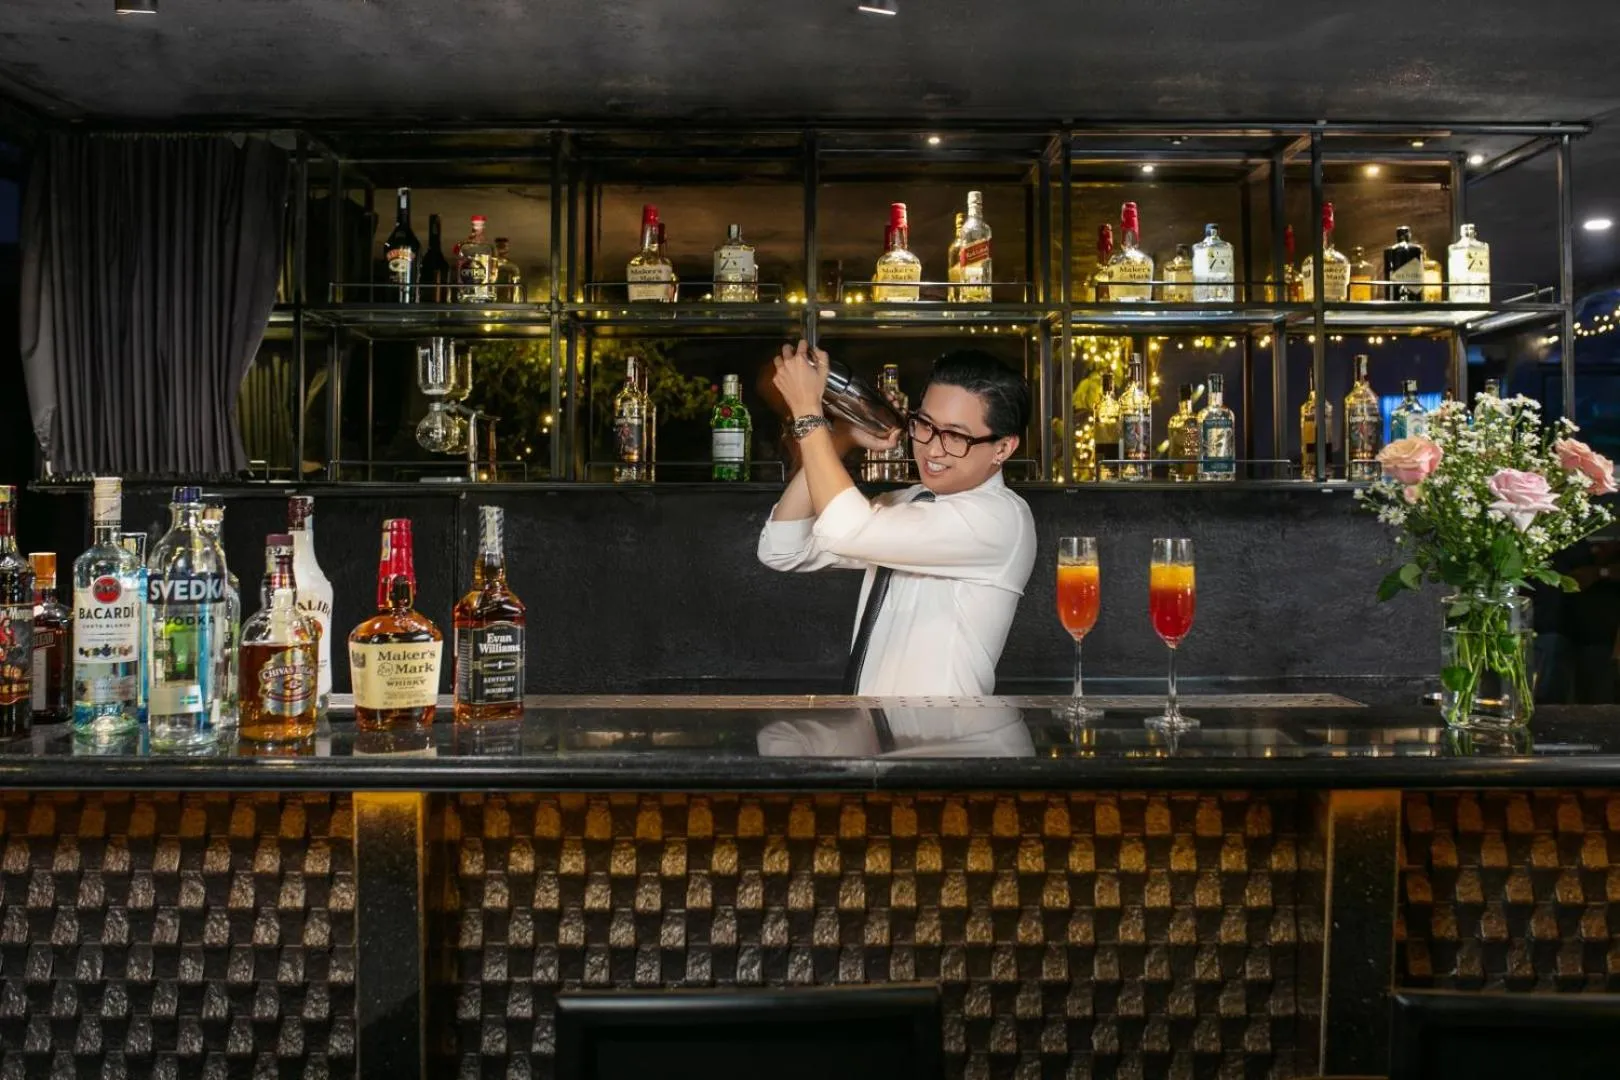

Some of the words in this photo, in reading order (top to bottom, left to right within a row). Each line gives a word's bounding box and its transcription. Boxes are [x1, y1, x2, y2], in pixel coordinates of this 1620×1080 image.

[297, 600, 331, 618] ALIB
[165, 615, 216, 626] VODKA
[487, 632, 513, 644] Evan
[478, 643, 521, 654] Williams
[377, 649, 436, 661] Maker's
[395, 662, 434, 675] Mark
[387, 679, 427, 688] WHISKY
